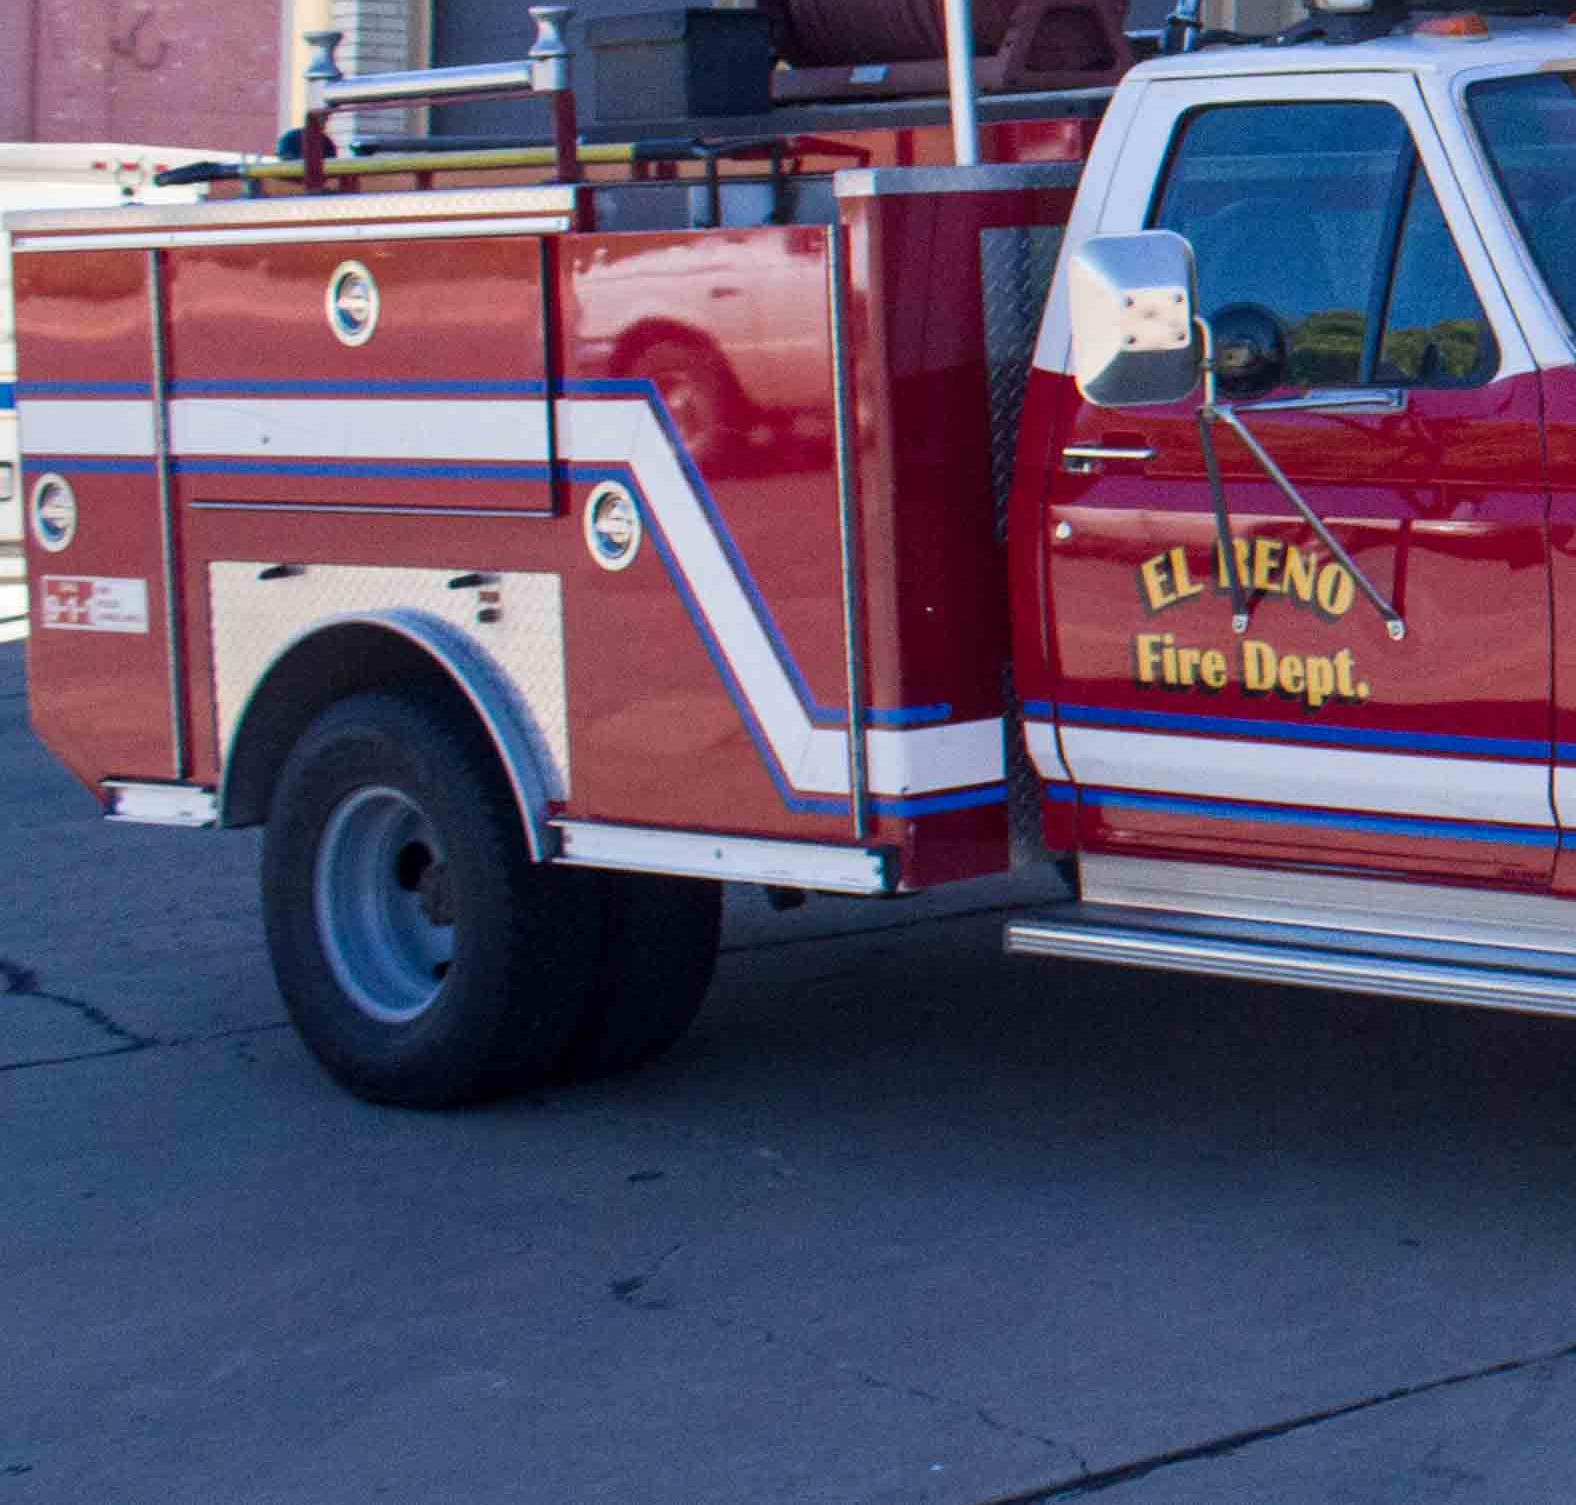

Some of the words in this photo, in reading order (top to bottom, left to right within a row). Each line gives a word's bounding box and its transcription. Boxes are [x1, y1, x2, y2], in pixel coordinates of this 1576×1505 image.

[1140, 545, 1204, 611] EL
[1136, 633, 1229, 688] Fire
[1242, 639, 1371, 708] Dept.
